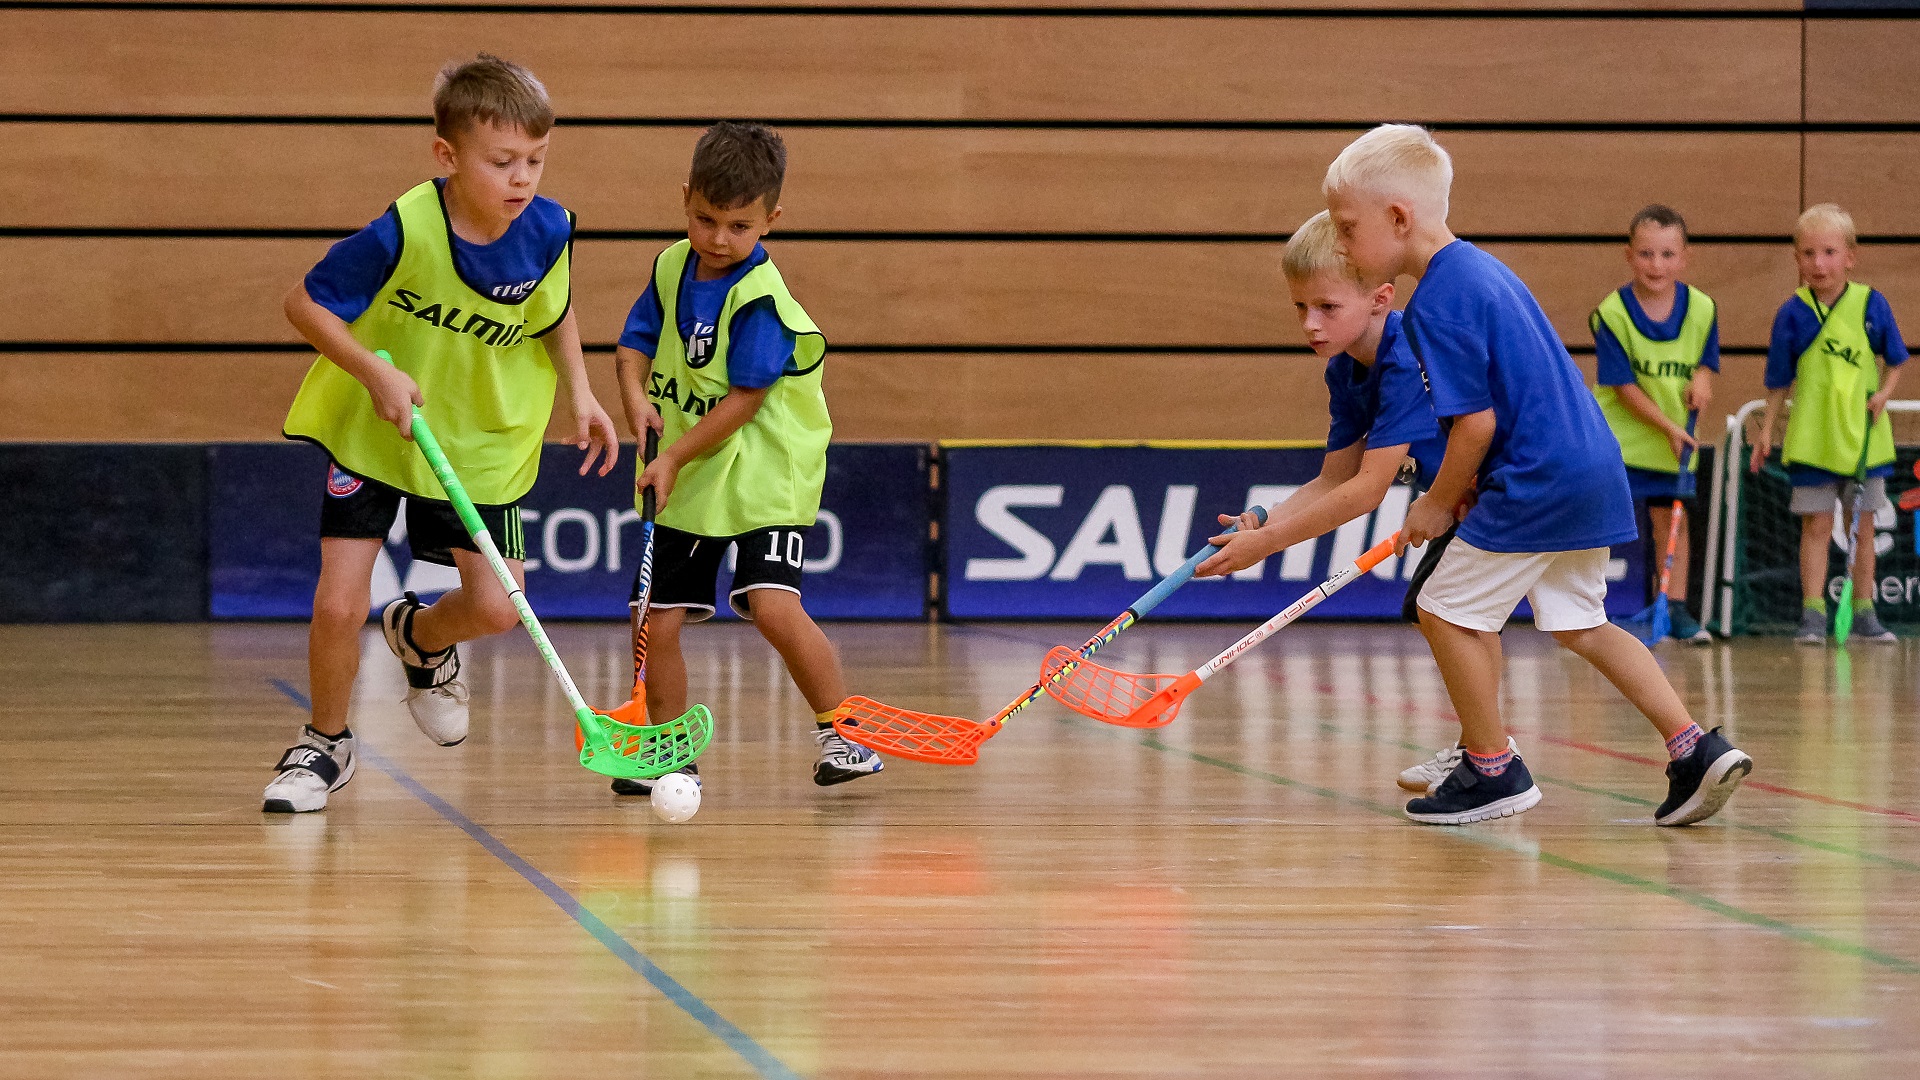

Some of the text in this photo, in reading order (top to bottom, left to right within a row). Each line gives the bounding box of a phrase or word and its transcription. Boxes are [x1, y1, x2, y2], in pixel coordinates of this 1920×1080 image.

[764, 530, 803, 567] 10
[519, 607, 560, 669] UNIHOC
[1213, 634, 1256, 669] UNIHOC
[283, 747, 322, 767] NIKE
